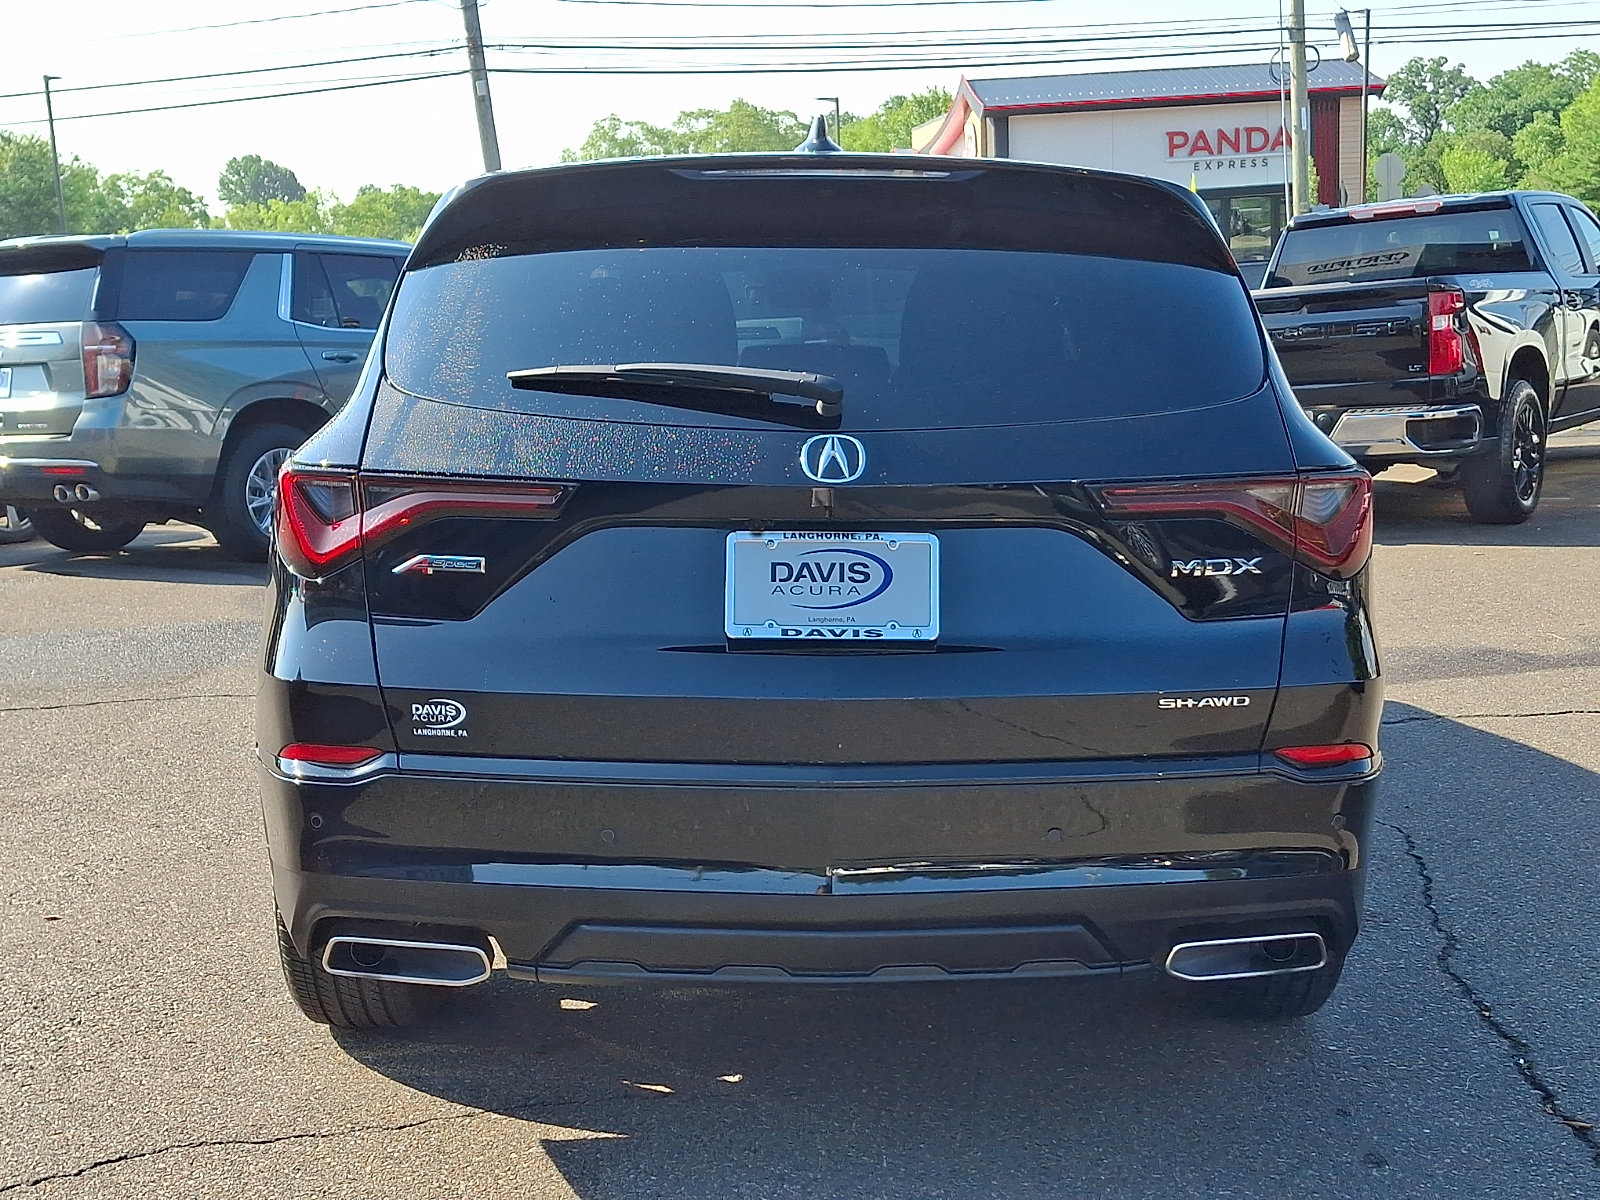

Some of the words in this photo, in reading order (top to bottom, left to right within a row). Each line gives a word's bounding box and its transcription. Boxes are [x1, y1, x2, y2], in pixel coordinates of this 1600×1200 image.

[1165, 125, 1292, 158] PANDA
[1193, 158, 1268, 171] EXPRESS
[769, 561, 871, 584] DAVIS
[1171, 557, 1263, 577] MDX
[771, 585, 861, 596] ACURA
[780, 628, 884, 638] DAVIS
[1158, 696, 1250, 709] SH-AWD
[411, 704, 457, 716] DAVIS
[412, 714, 454, 722] ACURA
